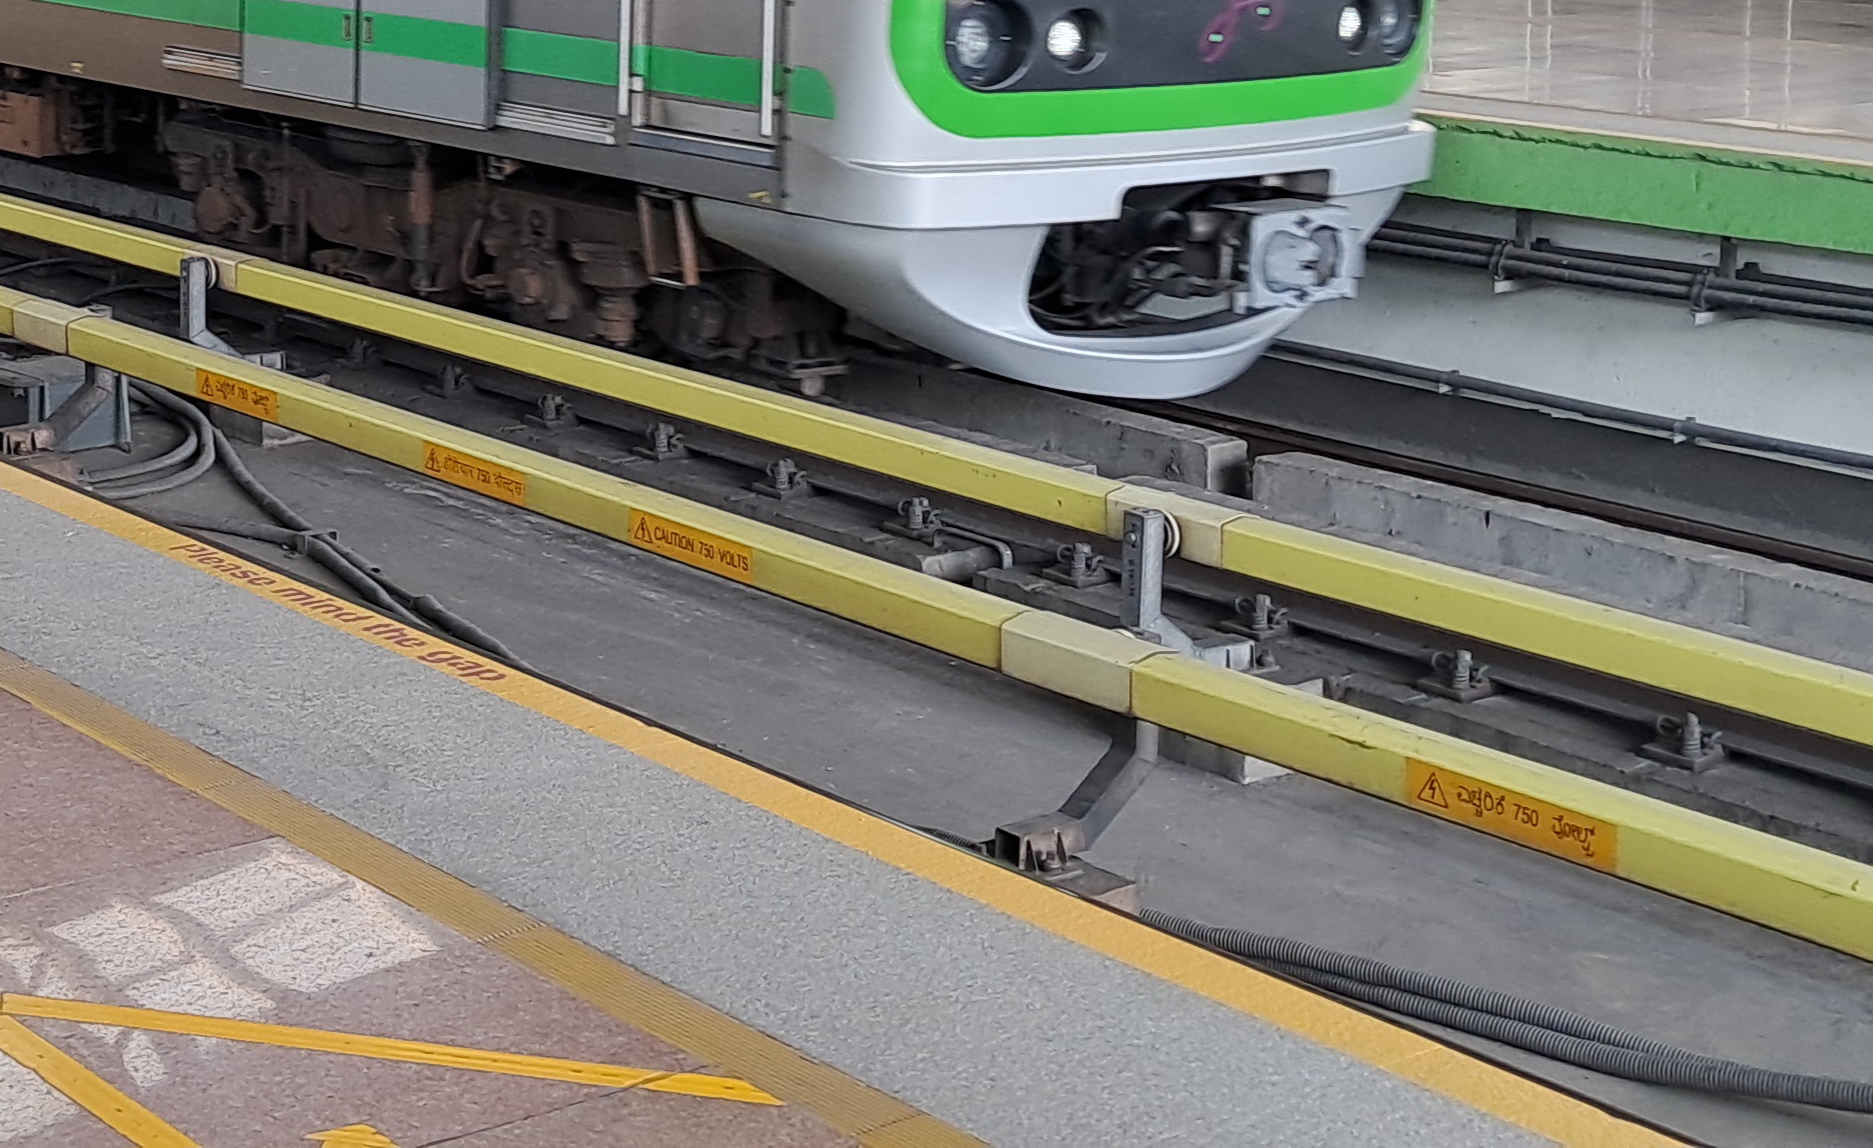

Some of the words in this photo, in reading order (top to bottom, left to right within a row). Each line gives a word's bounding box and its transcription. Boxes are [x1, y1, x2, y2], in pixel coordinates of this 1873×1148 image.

[653, 526, 695, 553] CAUTION
[698, 540, 715, 560] 750
[718, 547, 749, 572] VOLTS
[169, 543, 276, 587] Please
[270, 587, 374, 624] mind
[362, 622, 428, 649] the
[416, 650, 508, 682] gap
[1512, 802, 1540, 828] 750
